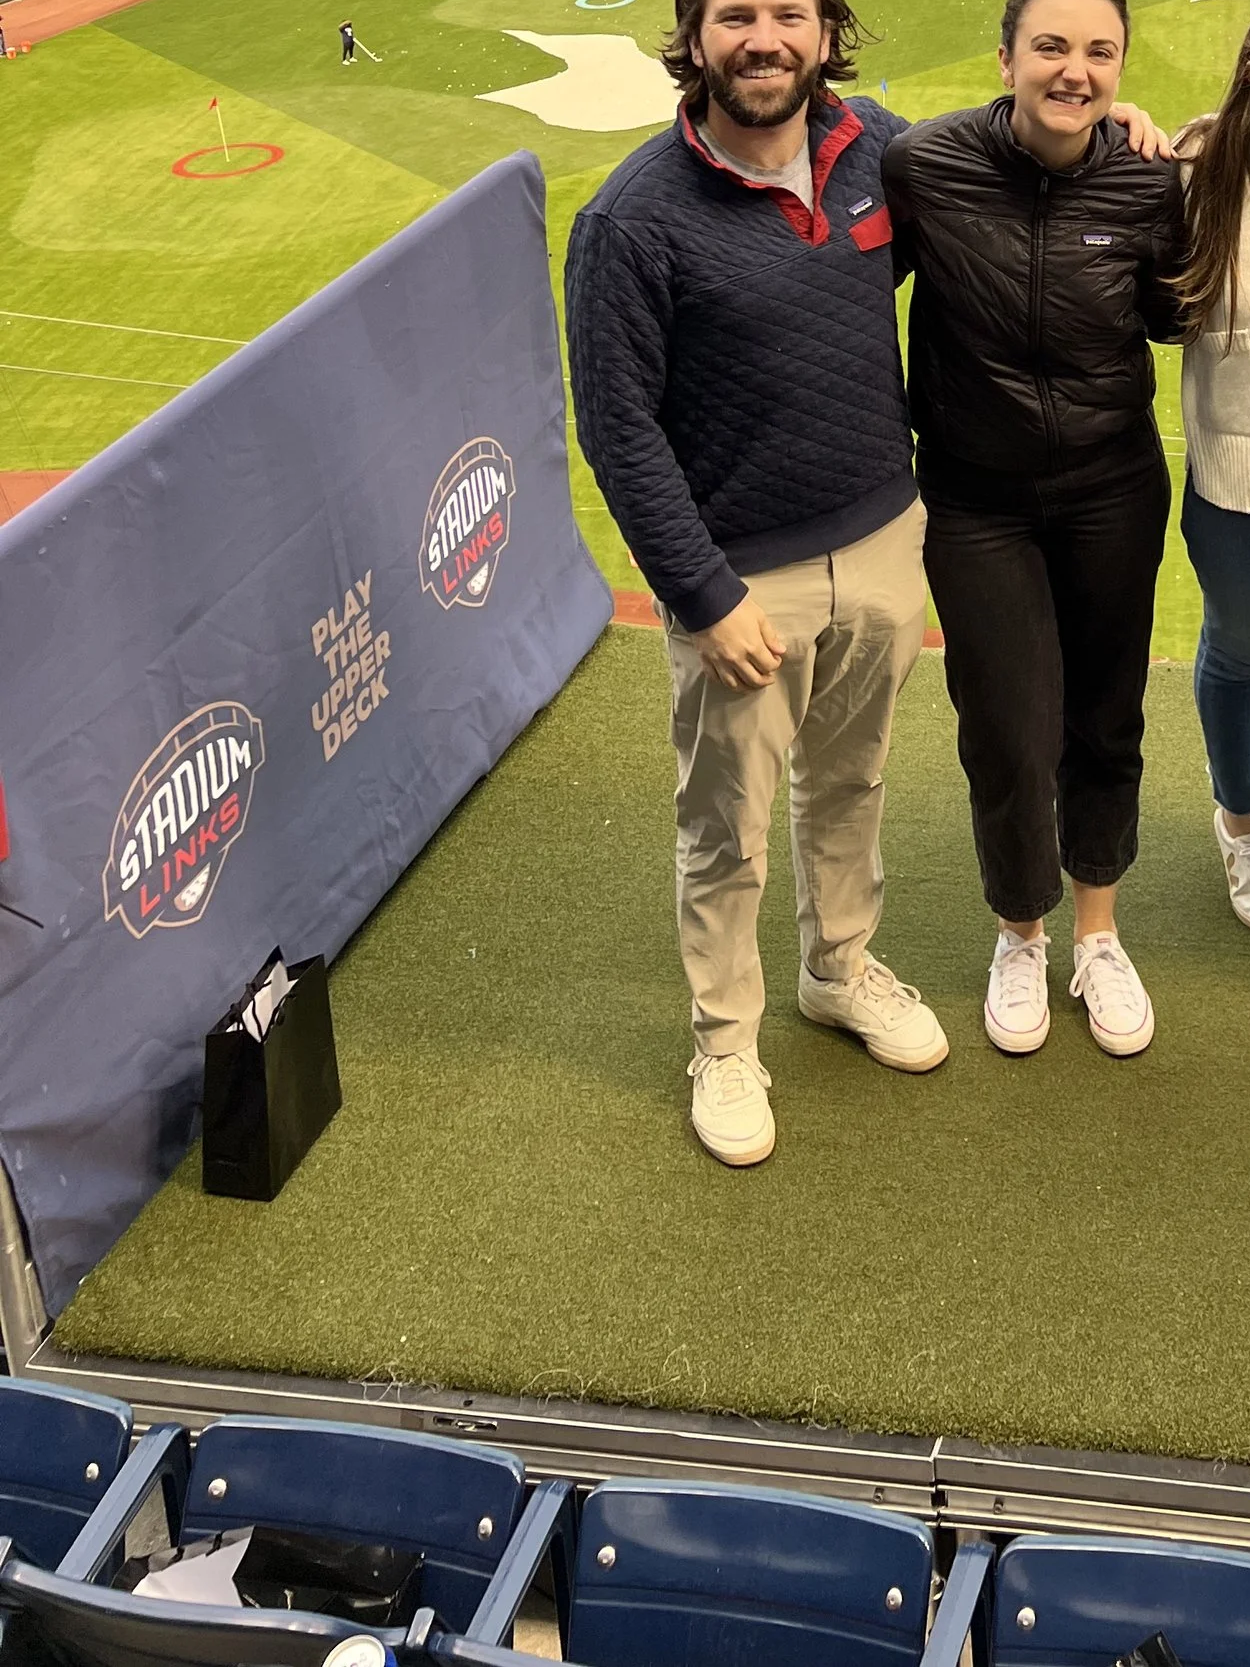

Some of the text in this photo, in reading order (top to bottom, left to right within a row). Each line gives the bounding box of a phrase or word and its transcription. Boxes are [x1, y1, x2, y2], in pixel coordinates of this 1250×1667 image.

[428, 465, 506, 572] STADIUM
[442, 511, 503, 595] LINKS
[311, 569, 372, 657] PLAY
[323, 610, 373, 680] THE
[311, 630, 391, 731] UPPER
[322, 667, 390, 763] DECK
[119, 736, 251, 892] STADIUM
[140, 792, 240, 918] LINKS
